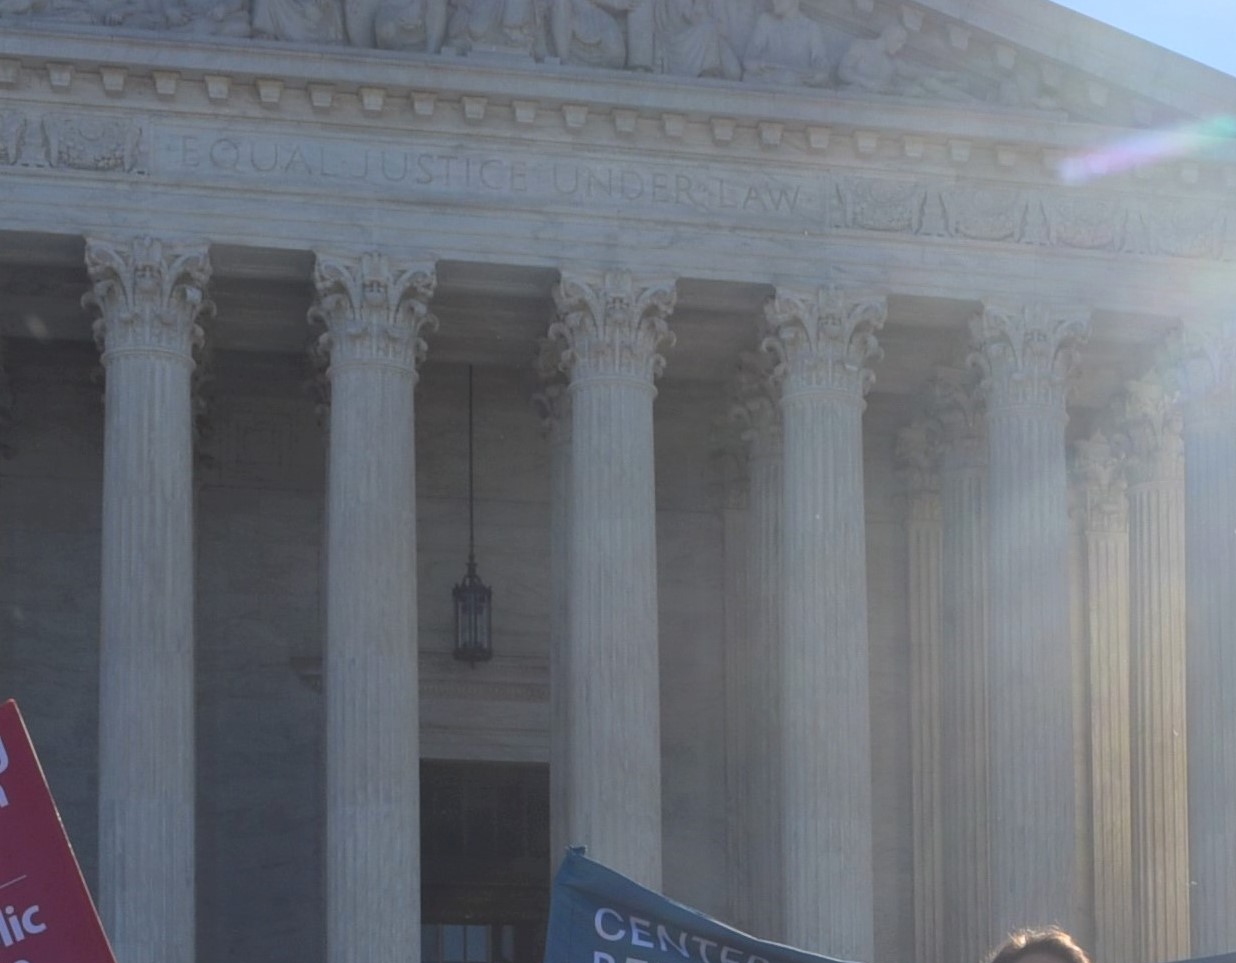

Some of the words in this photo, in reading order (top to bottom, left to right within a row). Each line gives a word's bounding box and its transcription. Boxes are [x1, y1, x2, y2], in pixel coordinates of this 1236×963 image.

[181, 137, 329, 177] EQUAL
[355, 149, 527, 193] JUSTICE
[552, 165, 693, 204] UNDER
[714, 177, 803, 215] LAW
